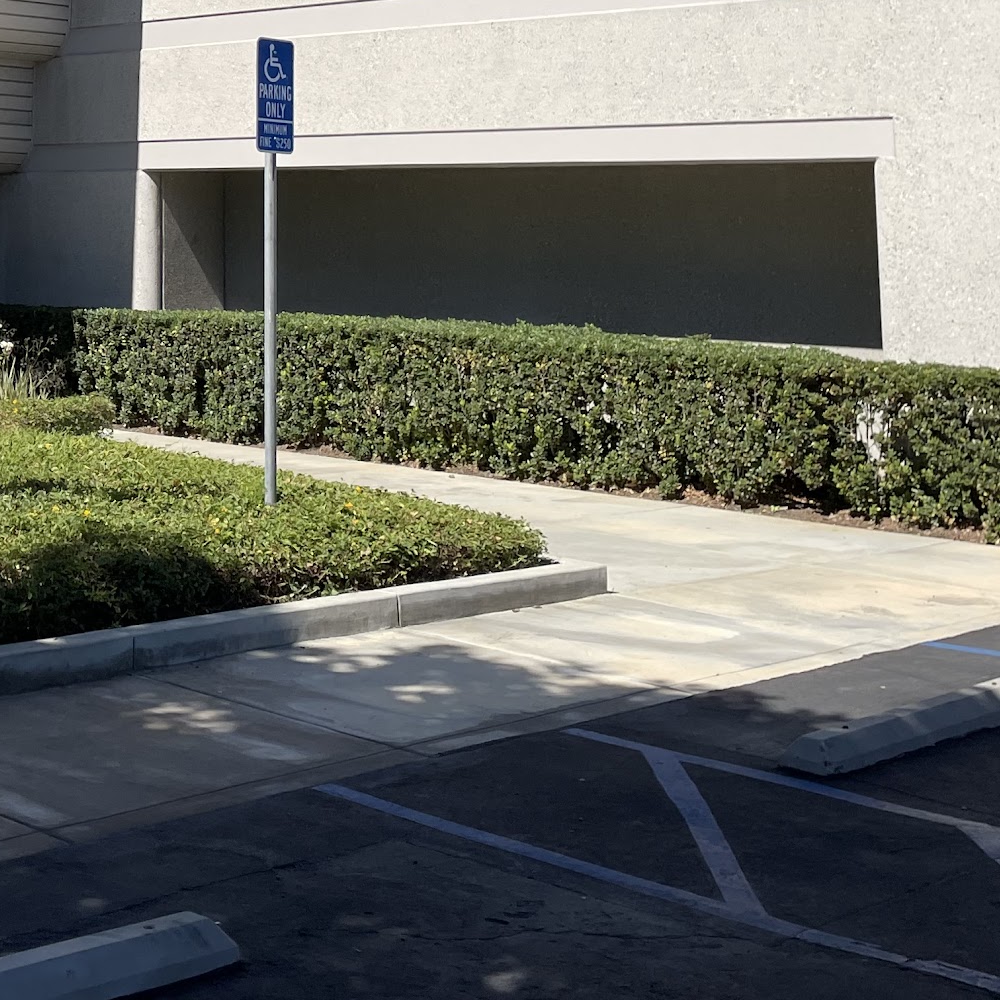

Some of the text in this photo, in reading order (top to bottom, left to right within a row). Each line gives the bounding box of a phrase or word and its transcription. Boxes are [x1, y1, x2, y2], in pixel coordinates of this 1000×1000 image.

[259, 83, 291, 102] PARKING
[265, 102, 286, 118] ONLY
[263, 123, 288, 135] MINIMUM
[259, 136, 291, 149] FINE $250
